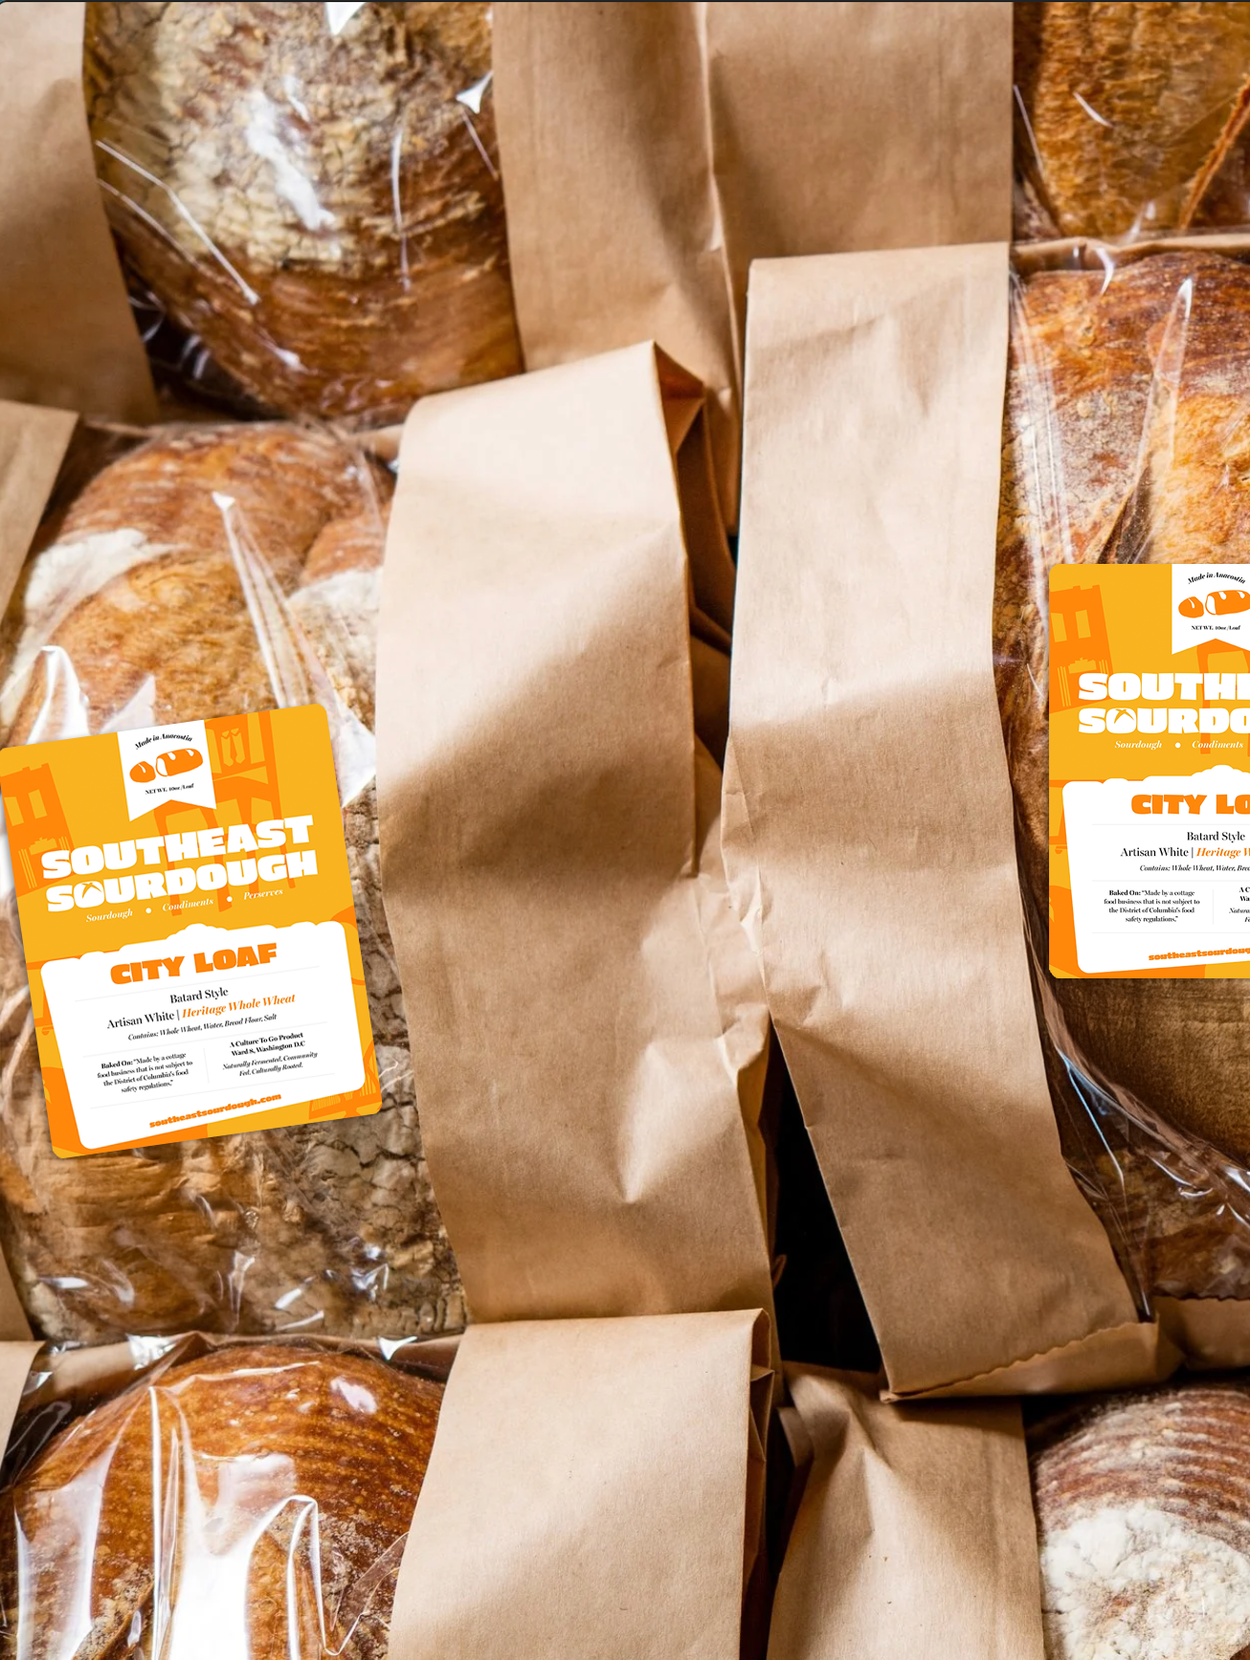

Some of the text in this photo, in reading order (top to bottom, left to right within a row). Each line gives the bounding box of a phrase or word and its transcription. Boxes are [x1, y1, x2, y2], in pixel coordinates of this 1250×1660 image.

[1187, 573, 1205, 583] Made
[1215, 571, 1245, 583] Anacostia
[134, 737, 152, 748] Made
[161, 733, 192, 741] Anacostia
[1114, 740, 1162, 751] Sourdough
[1191, 740, 1244, 749] Condiments
[1130, 793, 1207, 815] CITY
[1187, 830, 1245, 843] Batard Style
[40, 814, 313, 879] SOUTHEAST
[1120, 847, 1156, 856] Artisan
[1158, 846, 1188, 856] White
[1196, 847, 1241, 859] Heritage
[45, 849, 318, 912] SOURDOUGH
[1161, 889, 1168, 897] by
[85, 889, 283, 922] Sourdough Condiments Perserves
[1172, 898, 1192, 906] subject
[1125, 915, 1141, 923] safety
[109, 942, 277, 985] CITY LOAF
[169, 986, 228, 1003] Batard Style
[107, 994, 295, 1029] Artisan White Heritage Whole Wheat
[127, 1031, 158, 1040] Contains:
[159, 1027, 179, 1035] Whole
[224, 1017, 247, 1027] Bread
[244, 1016, 263, 1024] Flour,
[263, 1013, 276, 1021] Salt
[278, 1032, 303, 1040] Product
[231, 1048, 248, 1056] Ward
[255, 1043, 292, 1052] Washington
[223, 1060, 250, 1069] Naturally
[282, 1052, 317, 1061] Community
[251, 1065, 281, 1074] Culturally
[148, 1093, 281, 1128] southeastsourdough.com
